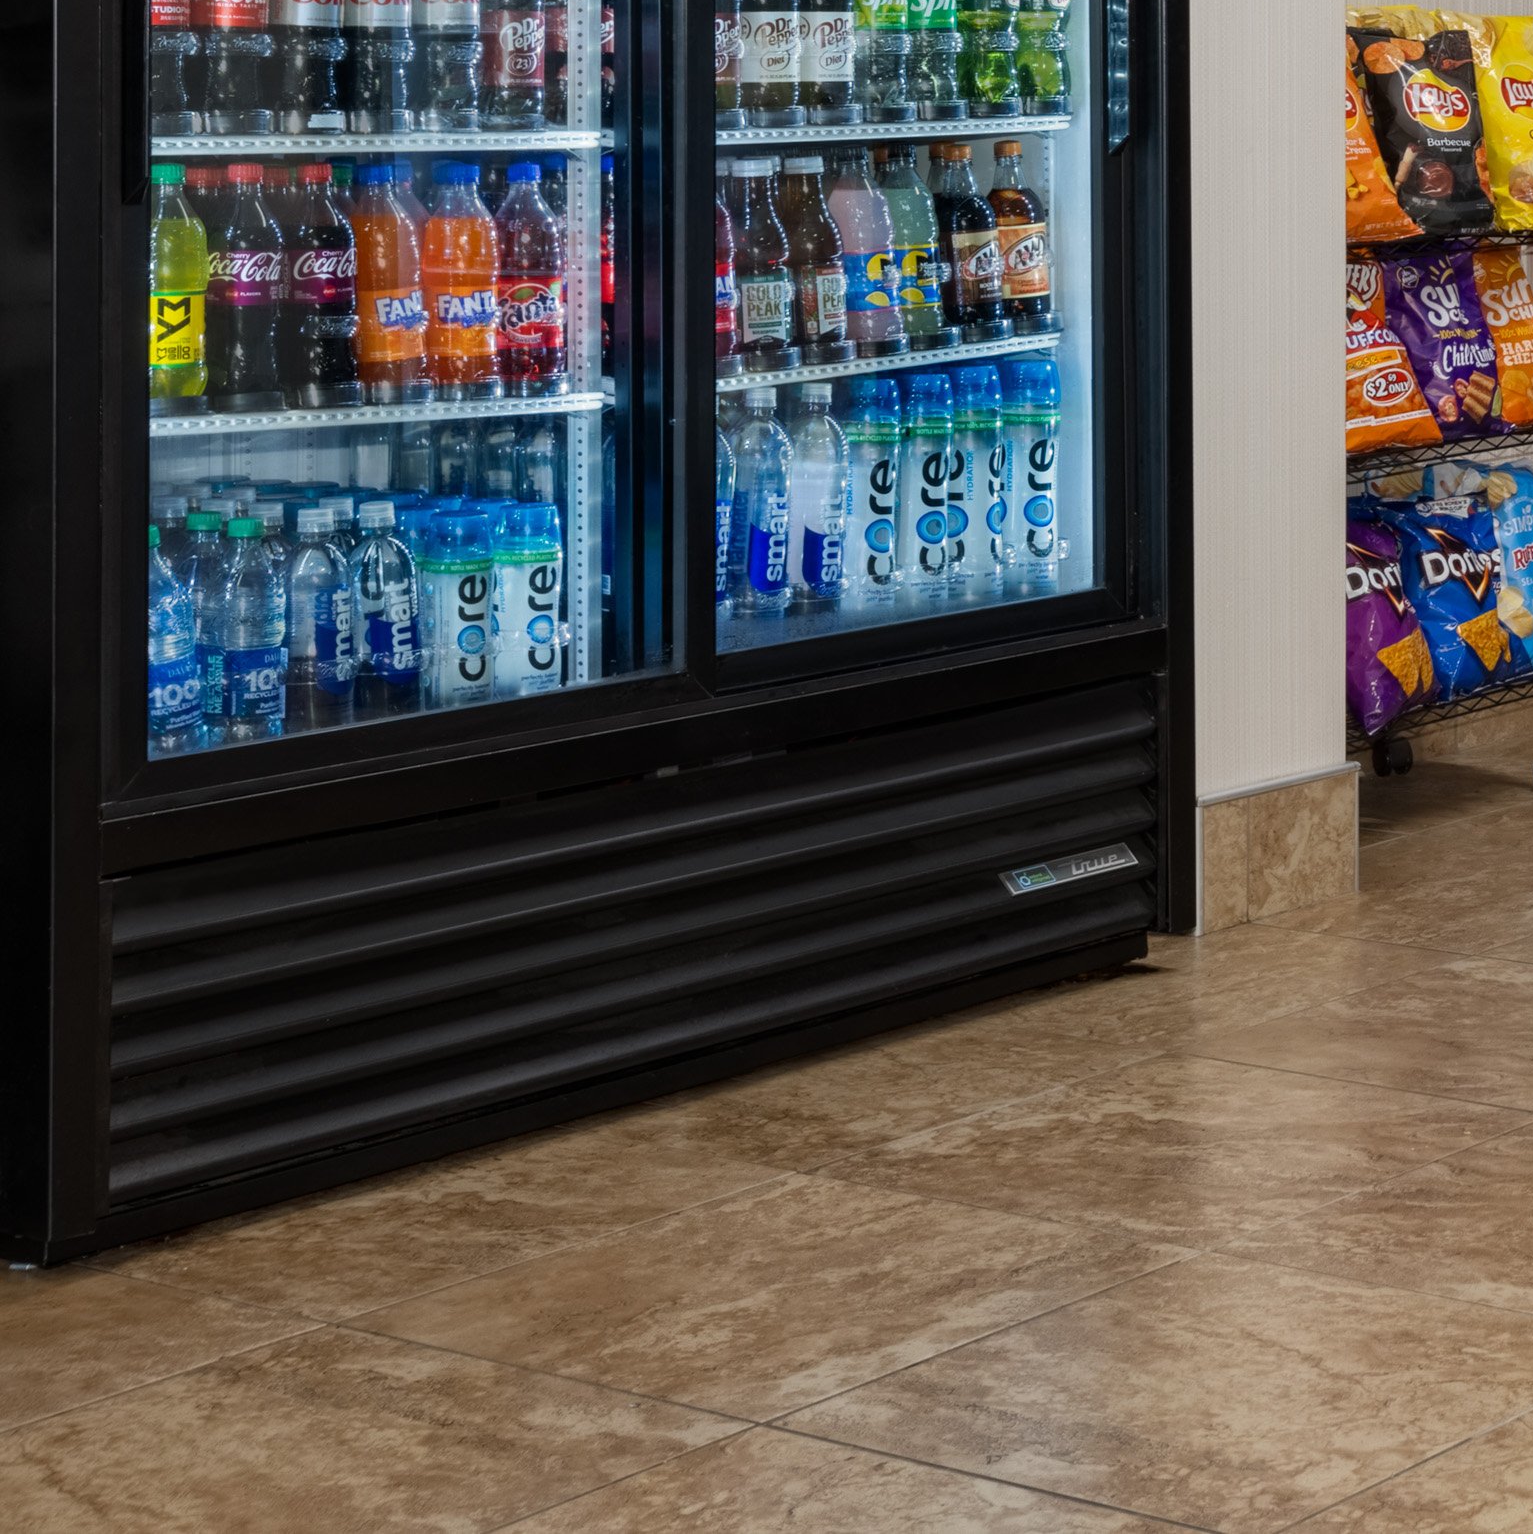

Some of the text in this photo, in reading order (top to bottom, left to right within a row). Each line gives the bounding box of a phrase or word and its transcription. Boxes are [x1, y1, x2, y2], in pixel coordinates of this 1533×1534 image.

[515, 57, 530, 69] 23
[767, 56, 785, 67] Diet
[824, 55, 842, 65] Diet
[1411, 83, 1464, 116] Lay's
[1427, 137, 1471, 147] Barbecue
[746, 283, 781, 302] GOLD
[748, 300, 781, 317] PEAK
[1023, 438, 1055, 558] core
[865, 459, 895, 586] core
[916, 451, 948, 577] core
[767, 494, 789, 582] smart
[457, 574, 487, 682] core
[527, 565, 557, 671] core
[1058, 854, 1125, 875] true
